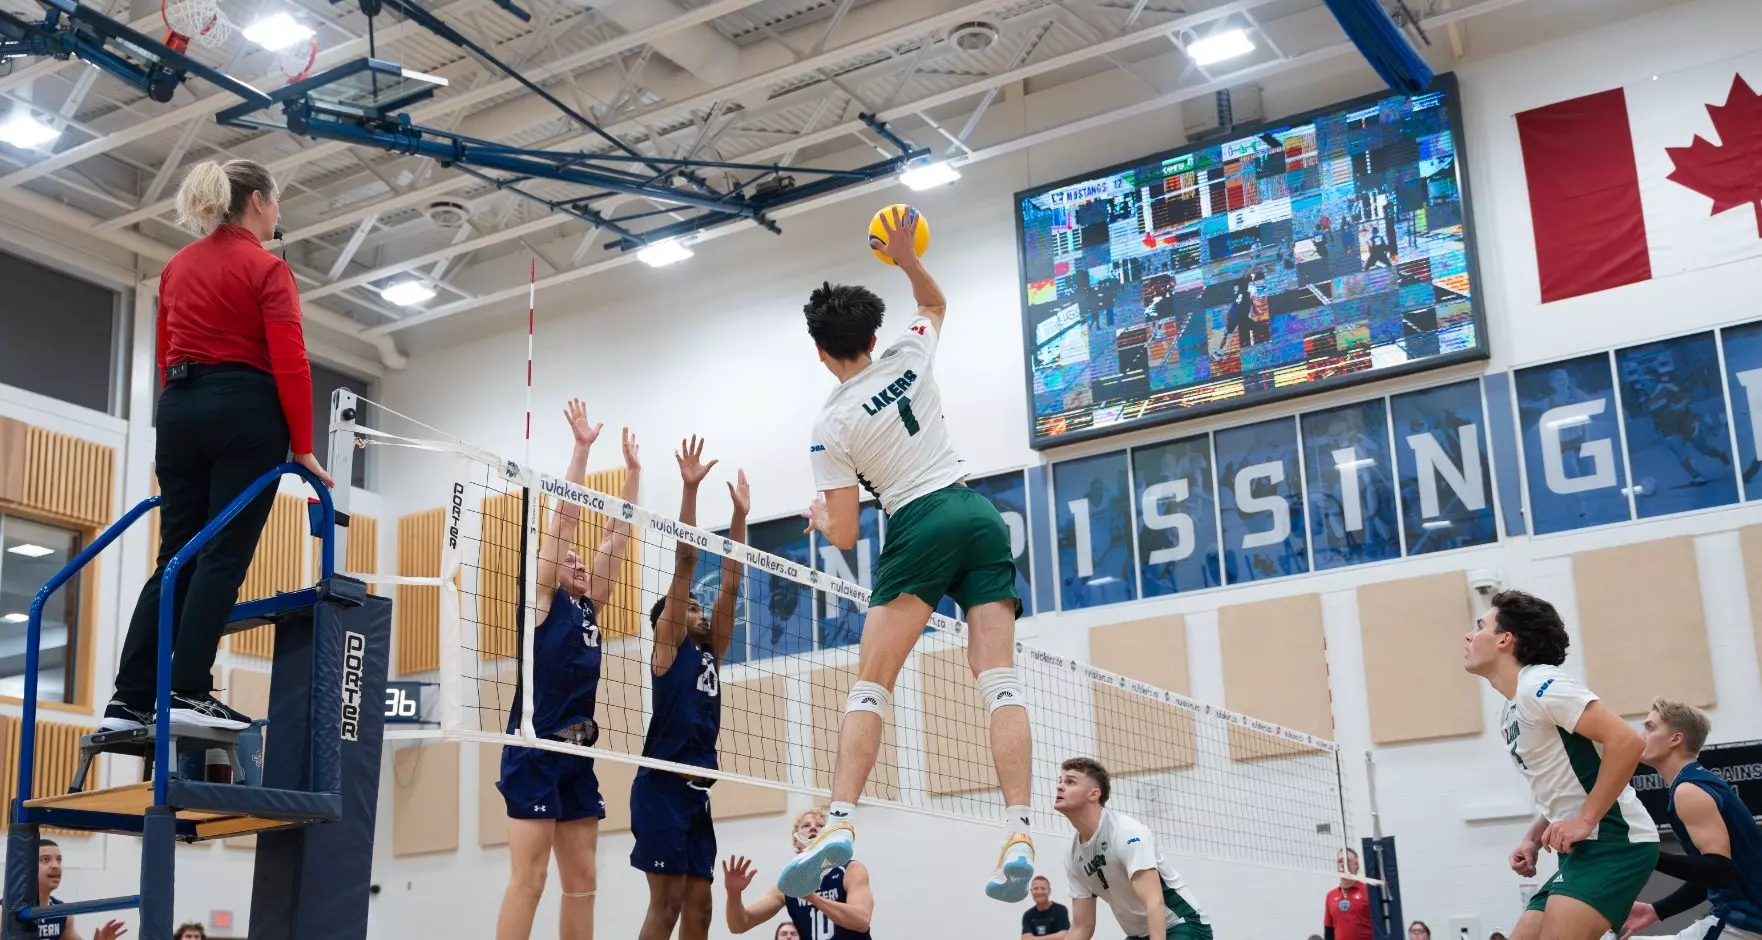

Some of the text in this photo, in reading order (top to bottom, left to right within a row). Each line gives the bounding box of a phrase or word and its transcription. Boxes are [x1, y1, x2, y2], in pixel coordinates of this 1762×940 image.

[1066, 181, 1107, 201] MUSTANGS
[861, 369, 918, 417] LAKERS
[896, 395, 921, 437] 1
[449, 482, 464, 550] PORTER
[650, 518, 708, 547] nulakers.ca
[746, 551, 798, 578] nulakers.ca
[830, 580, 872, 603] nulakers.c
[341, 634, 363, 738] PORTER
[809, 907, 835, 940] 10
